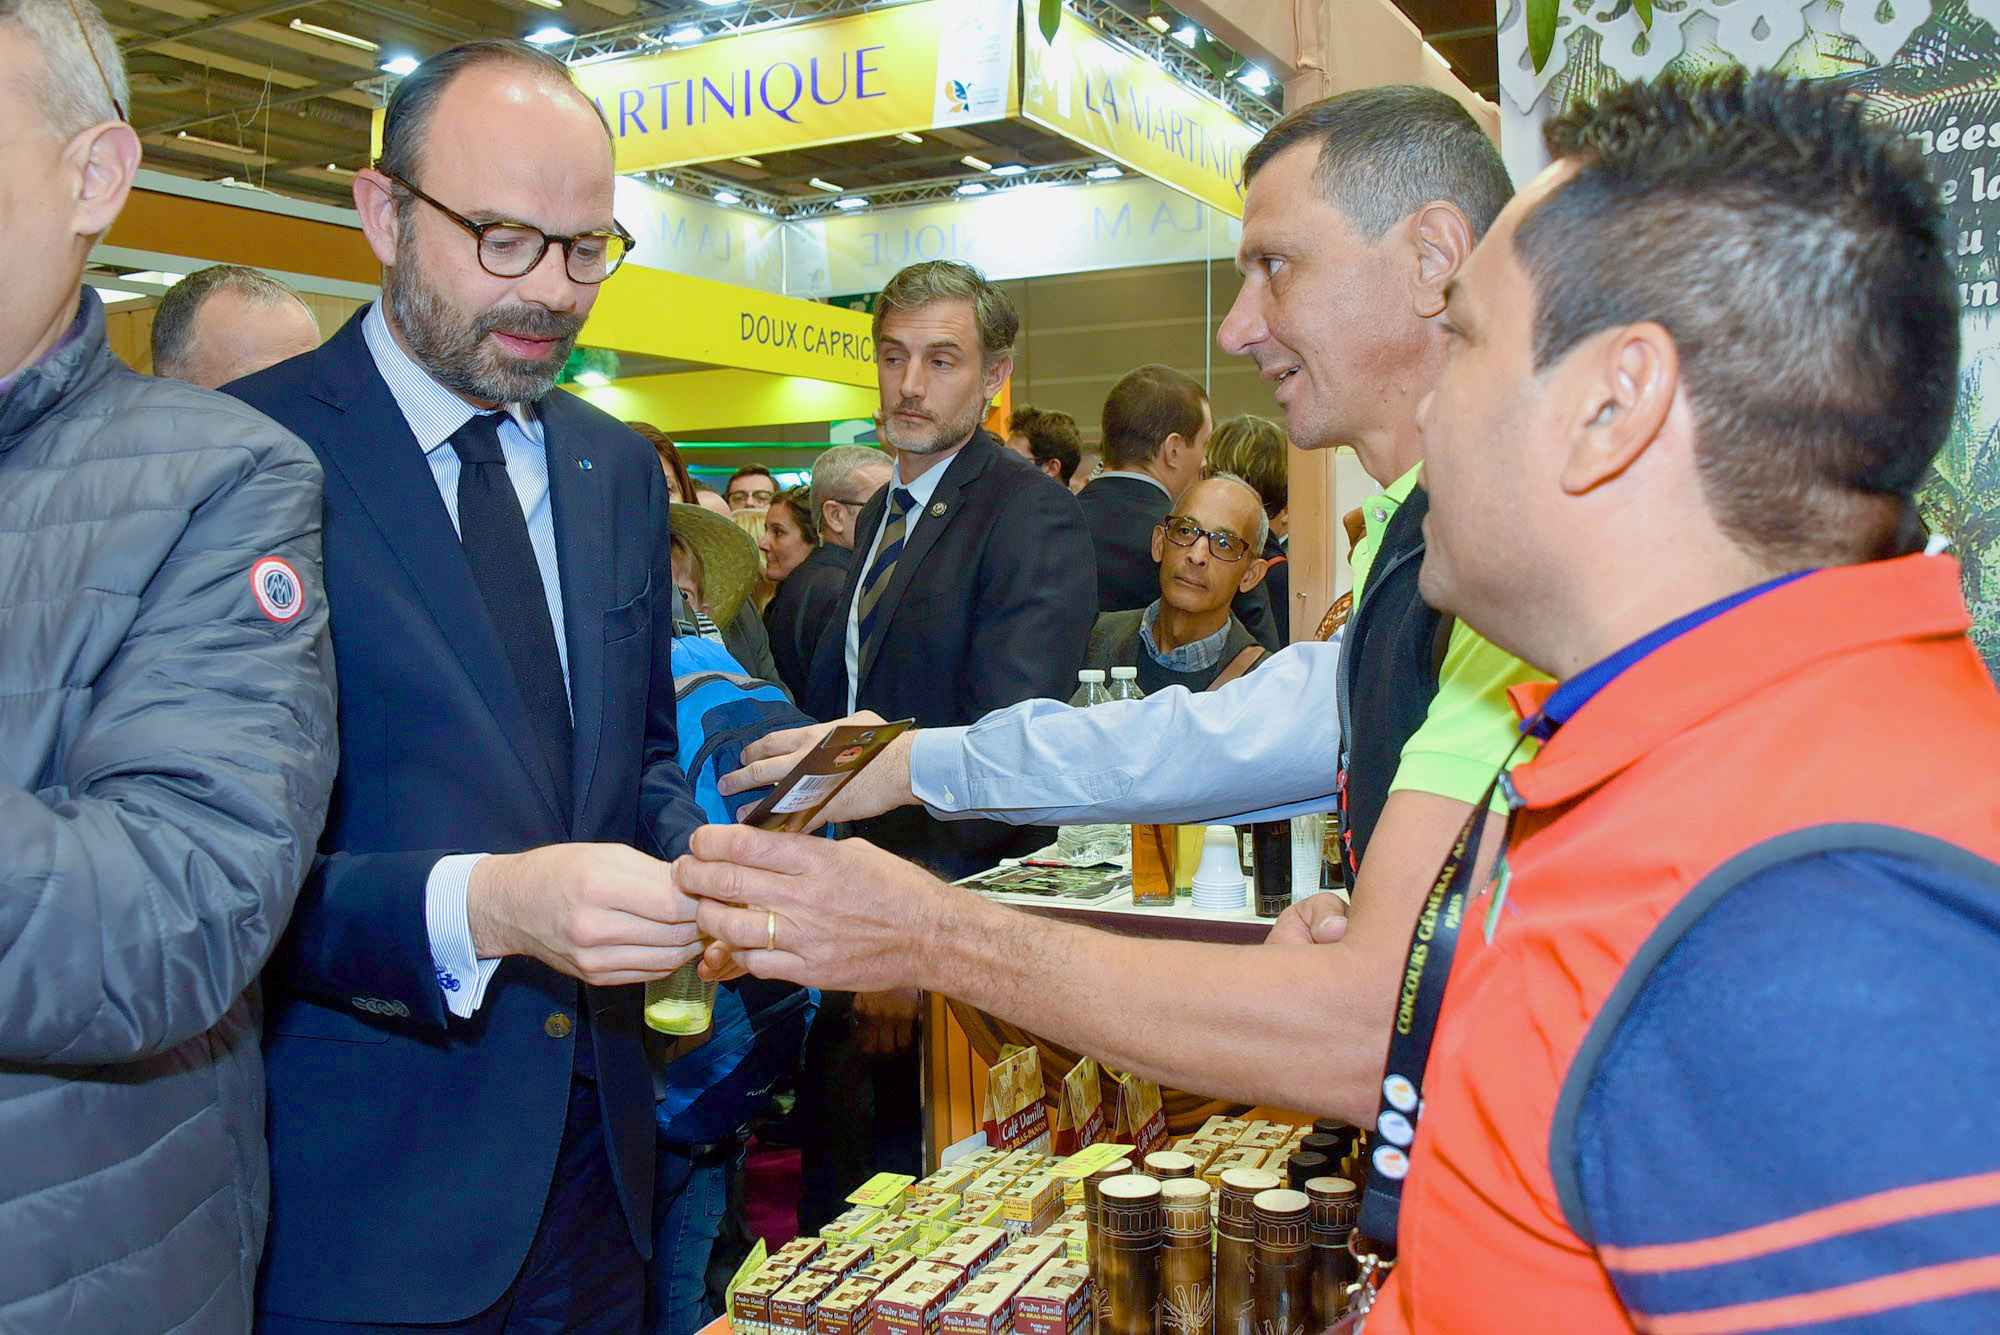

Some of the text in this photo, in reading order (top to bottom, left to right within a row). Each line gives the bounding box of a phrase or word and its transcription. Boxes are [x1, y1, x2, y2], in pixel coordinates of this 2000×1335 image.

[1086, 74, 1119, 124] LA
[741, 312, 797, 350] DOUX
[1445, 893, 1463, 928] PARIS
[1397, 942, 1429, 1035] CONCOURS
[1002, 1102, 1045, 1140] Café Vanille
[877, 1304, 920, 1322] Poudre Vanille
[1018, 1301, 1064, 1316] Poudre Vanille
[884, 1316, 918, 1328] BRAS-PANON
[943, 1314, 965, 1327] Poudre
[965, 1317, 987, 1330] Vanille
[1026, 1313, 1062, 1323] BRAS-PANON
[951, 1326, 986, 1335] BRAS-PANON
